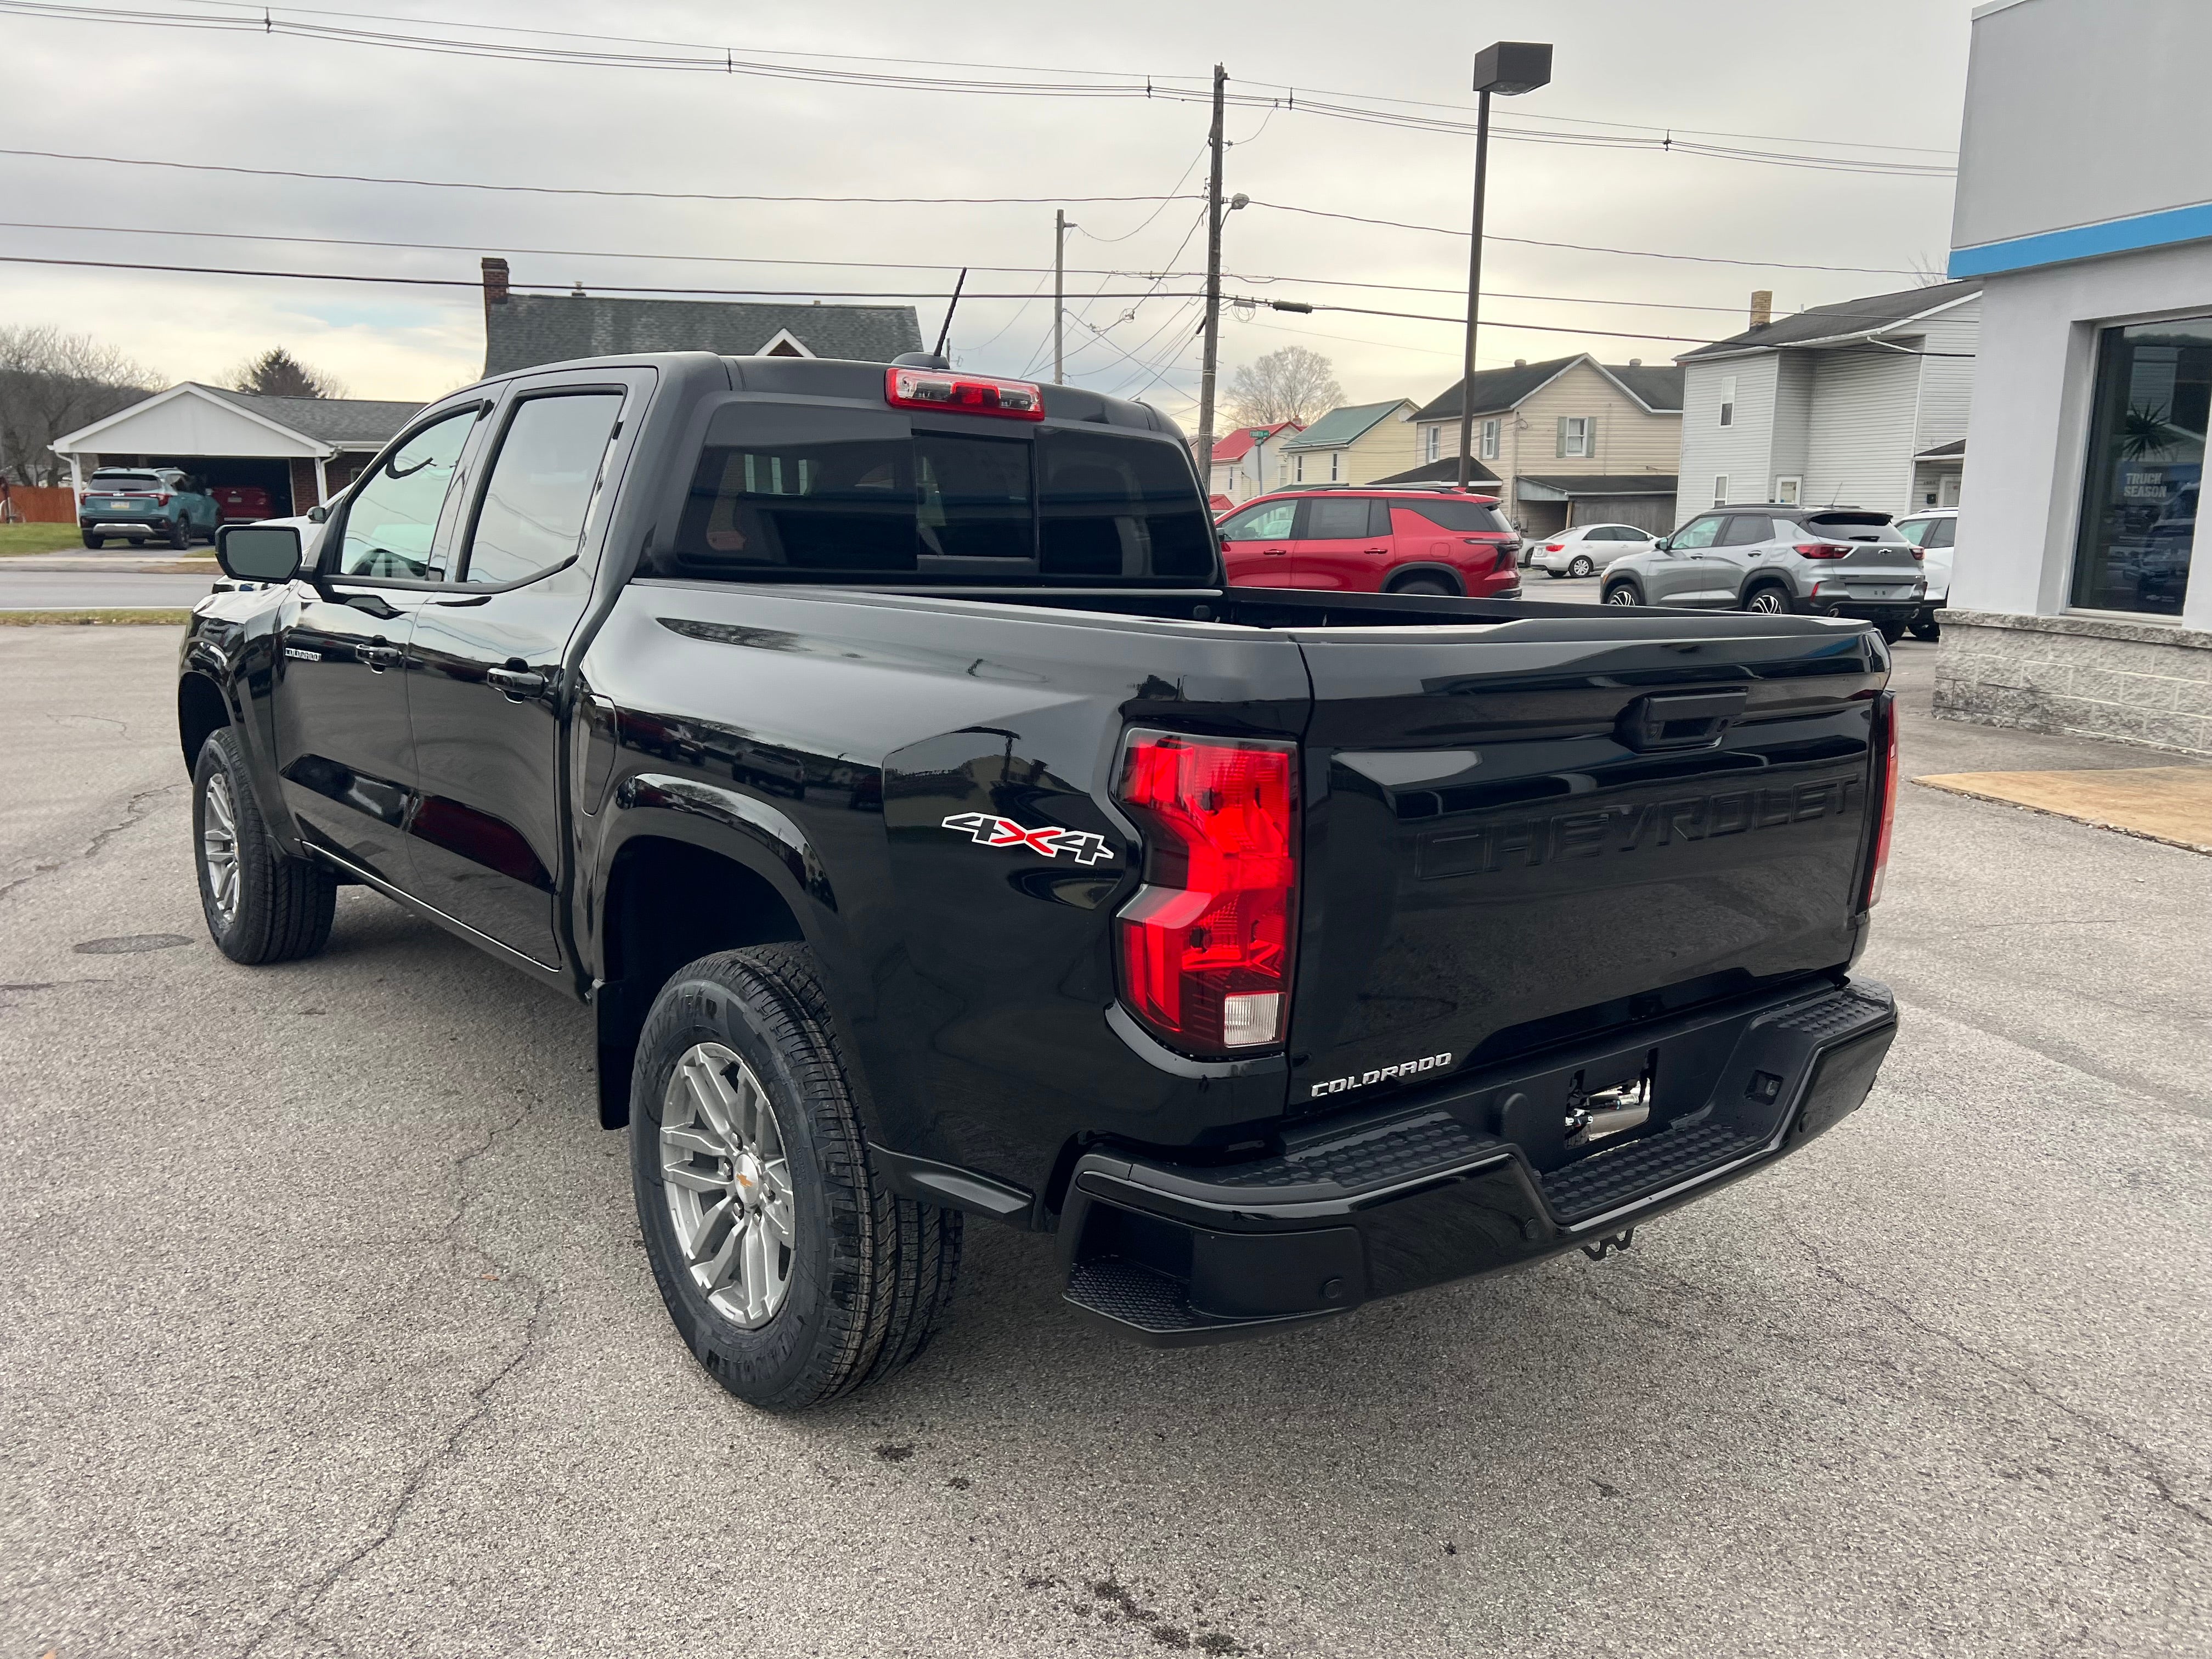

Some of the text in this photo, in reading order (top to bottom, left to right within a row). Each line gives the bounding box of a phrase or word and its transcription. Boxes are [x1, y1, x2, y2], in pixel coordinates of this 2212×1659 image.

[2124, 486, 2167, 498] SEASON
[2126, 472, 2163, 484] TRUCK
[1415, 772, 1859, 881] CHEVROLET
[1311, 1052, 1452, 1097] COLORADO
